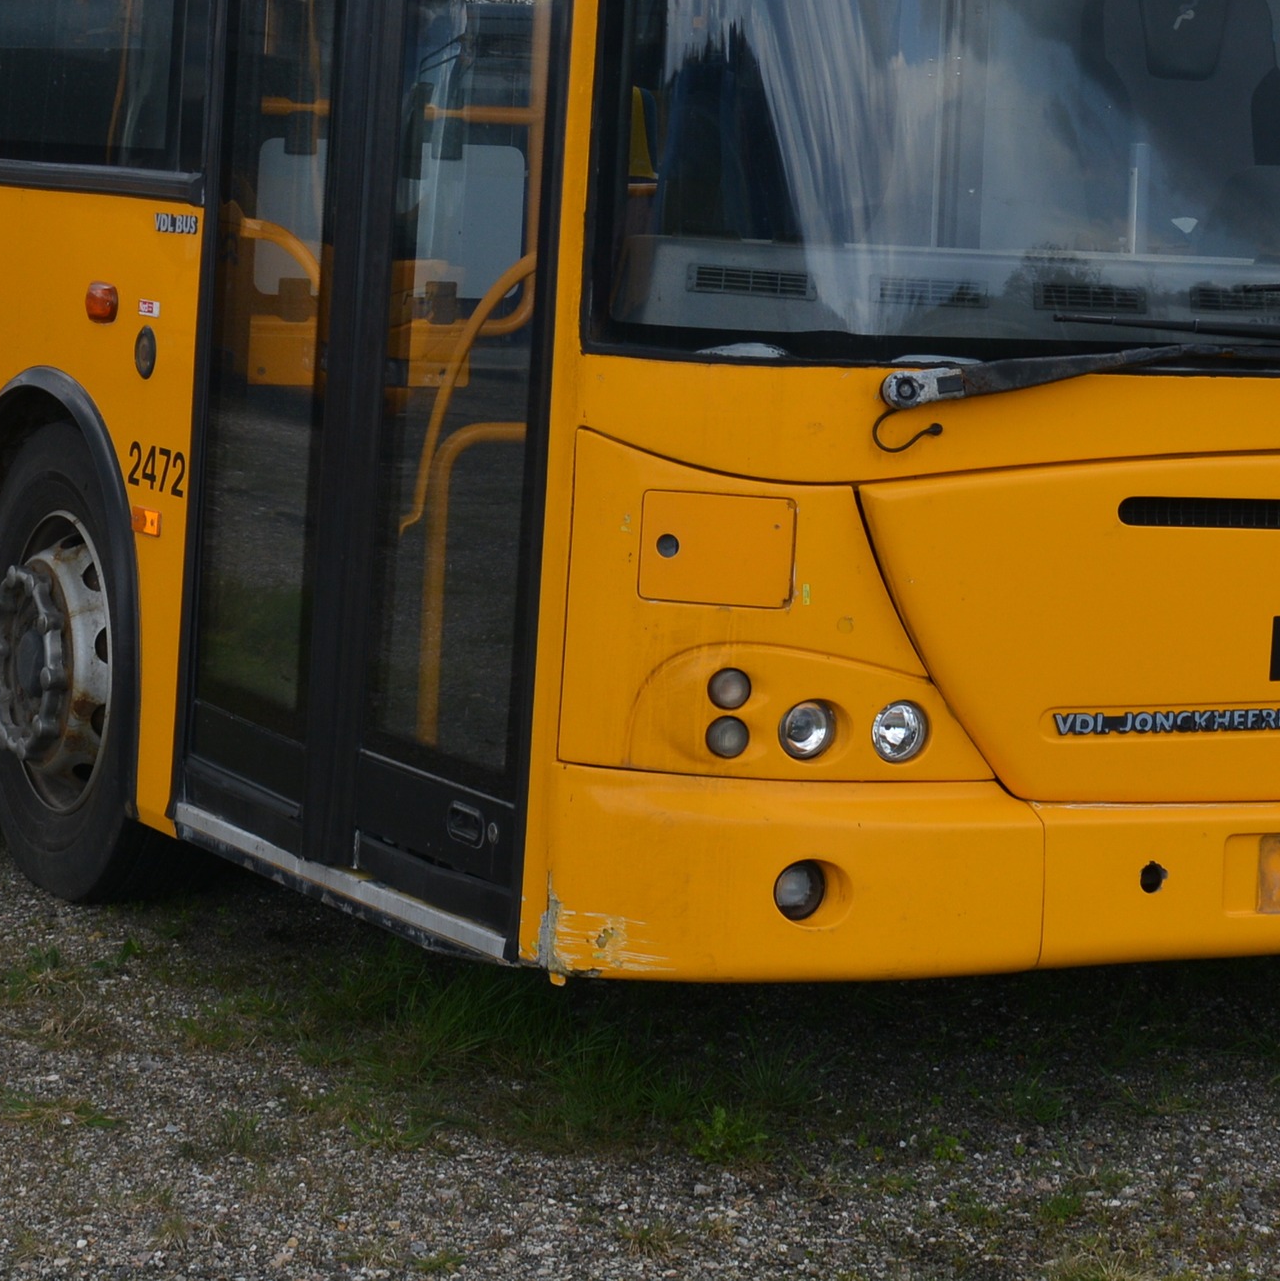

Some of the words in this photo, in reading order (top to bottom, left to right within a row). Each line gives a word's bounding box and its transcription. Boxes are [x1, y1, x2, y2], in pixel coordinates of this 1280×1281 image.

[154, 213, 174, 233] VDL
[175, 214, 198, 235] BUS
[127, 440, 186, 498] 2472
